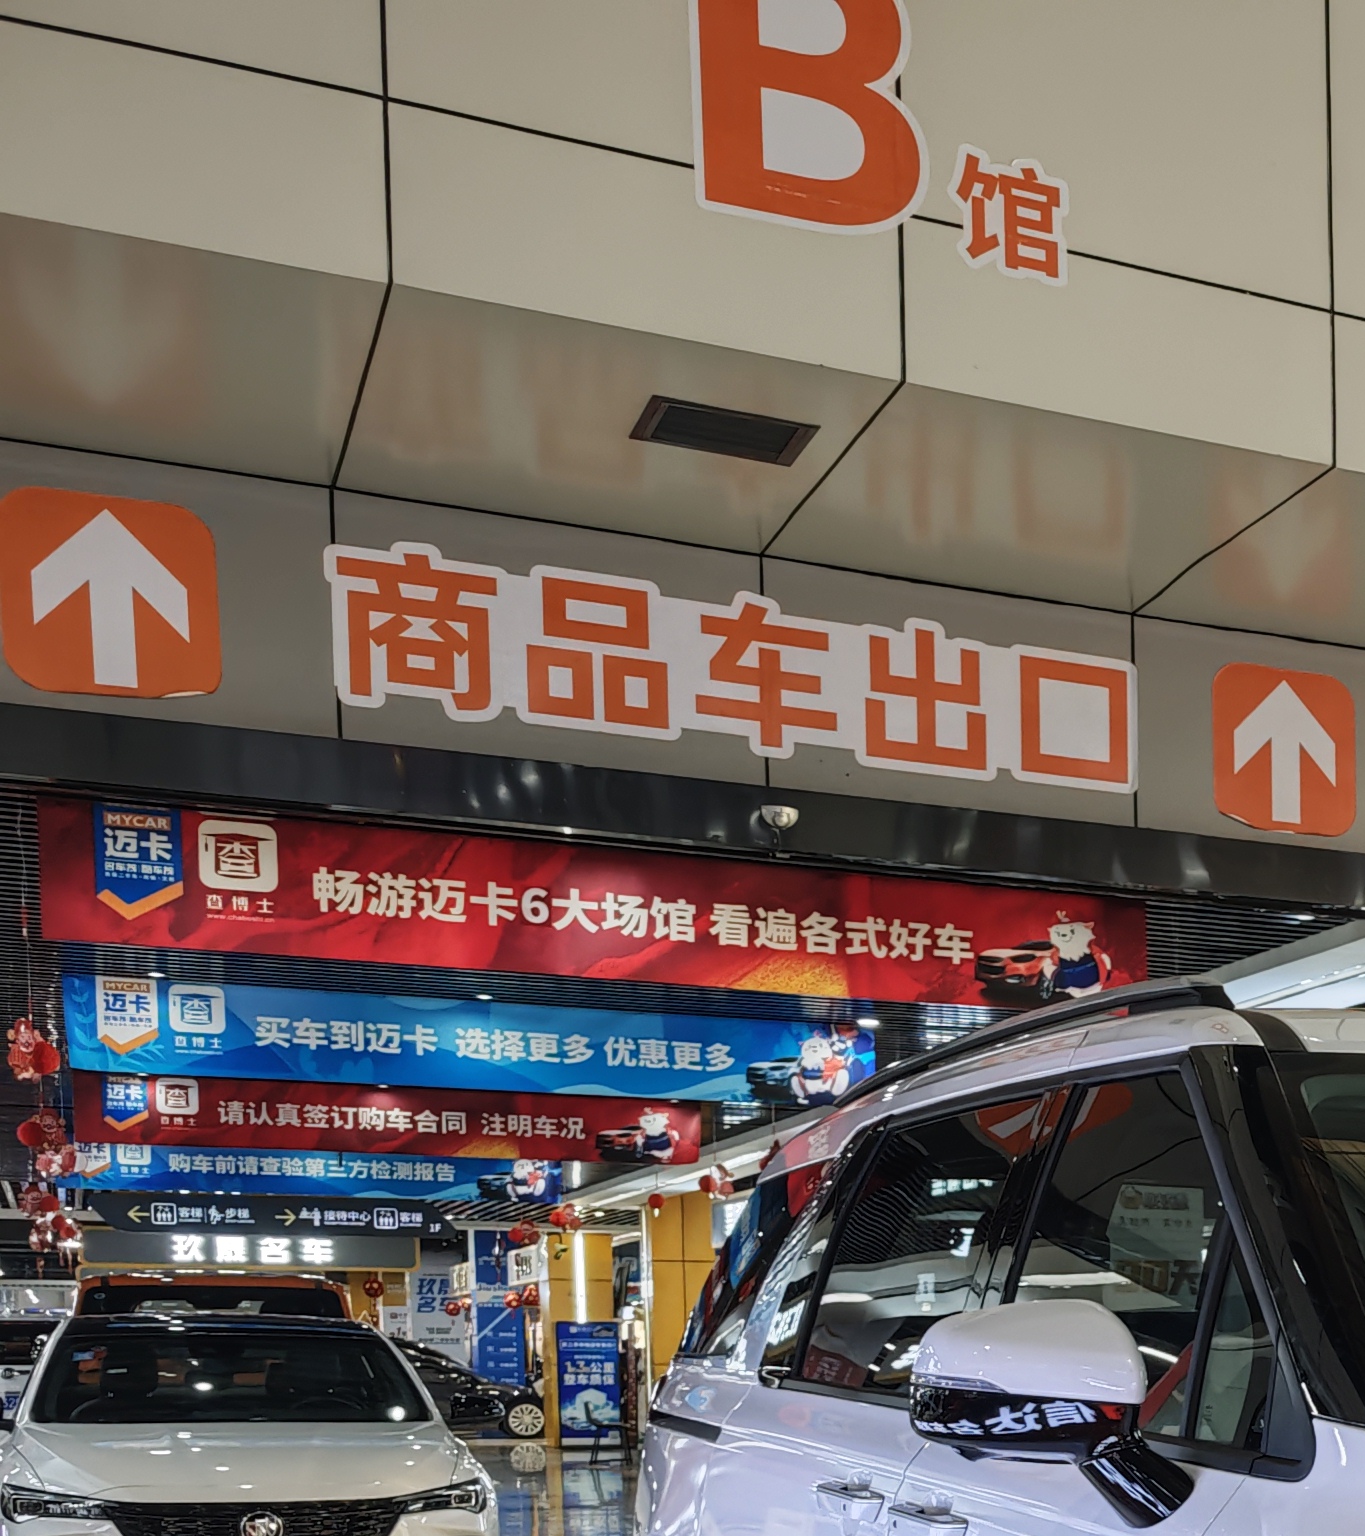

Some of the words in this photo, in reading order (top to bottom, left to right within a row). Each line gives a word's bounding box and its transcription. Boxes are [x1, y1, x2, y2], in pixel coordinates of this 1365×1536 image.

[333, 552, 1132, 788] 商品车出口
[107, 813, 169, 829] MYCAR
[103, 827, 173, 862] 迈卡
[205, 894, 275, 914] 查博士
[311, 865, 697, 944] 畅游迈卡6大场馆
[708, 902, 976, 966] 看遍各式好车
[105, 981, 148, 993] MYCAR
[102, 991, 151, 1014] 迈卡
[254, 1015, 439, 1056] 买车到迈卡
[455, 1028, 594, 1066] 选择更多
[603, 1036, 736, 1074] 优惠更多
[105, 1083, 144, 1101] 迈卡
[218, 1100, 468, 1135] 请认真签订购车合同
[481, 1111, 586, 1142] 注明车况
[167, 1153, 457, 1184] 购车前请查验第三方检测报告
[323, 1209, 372, 1223] 接待中心
